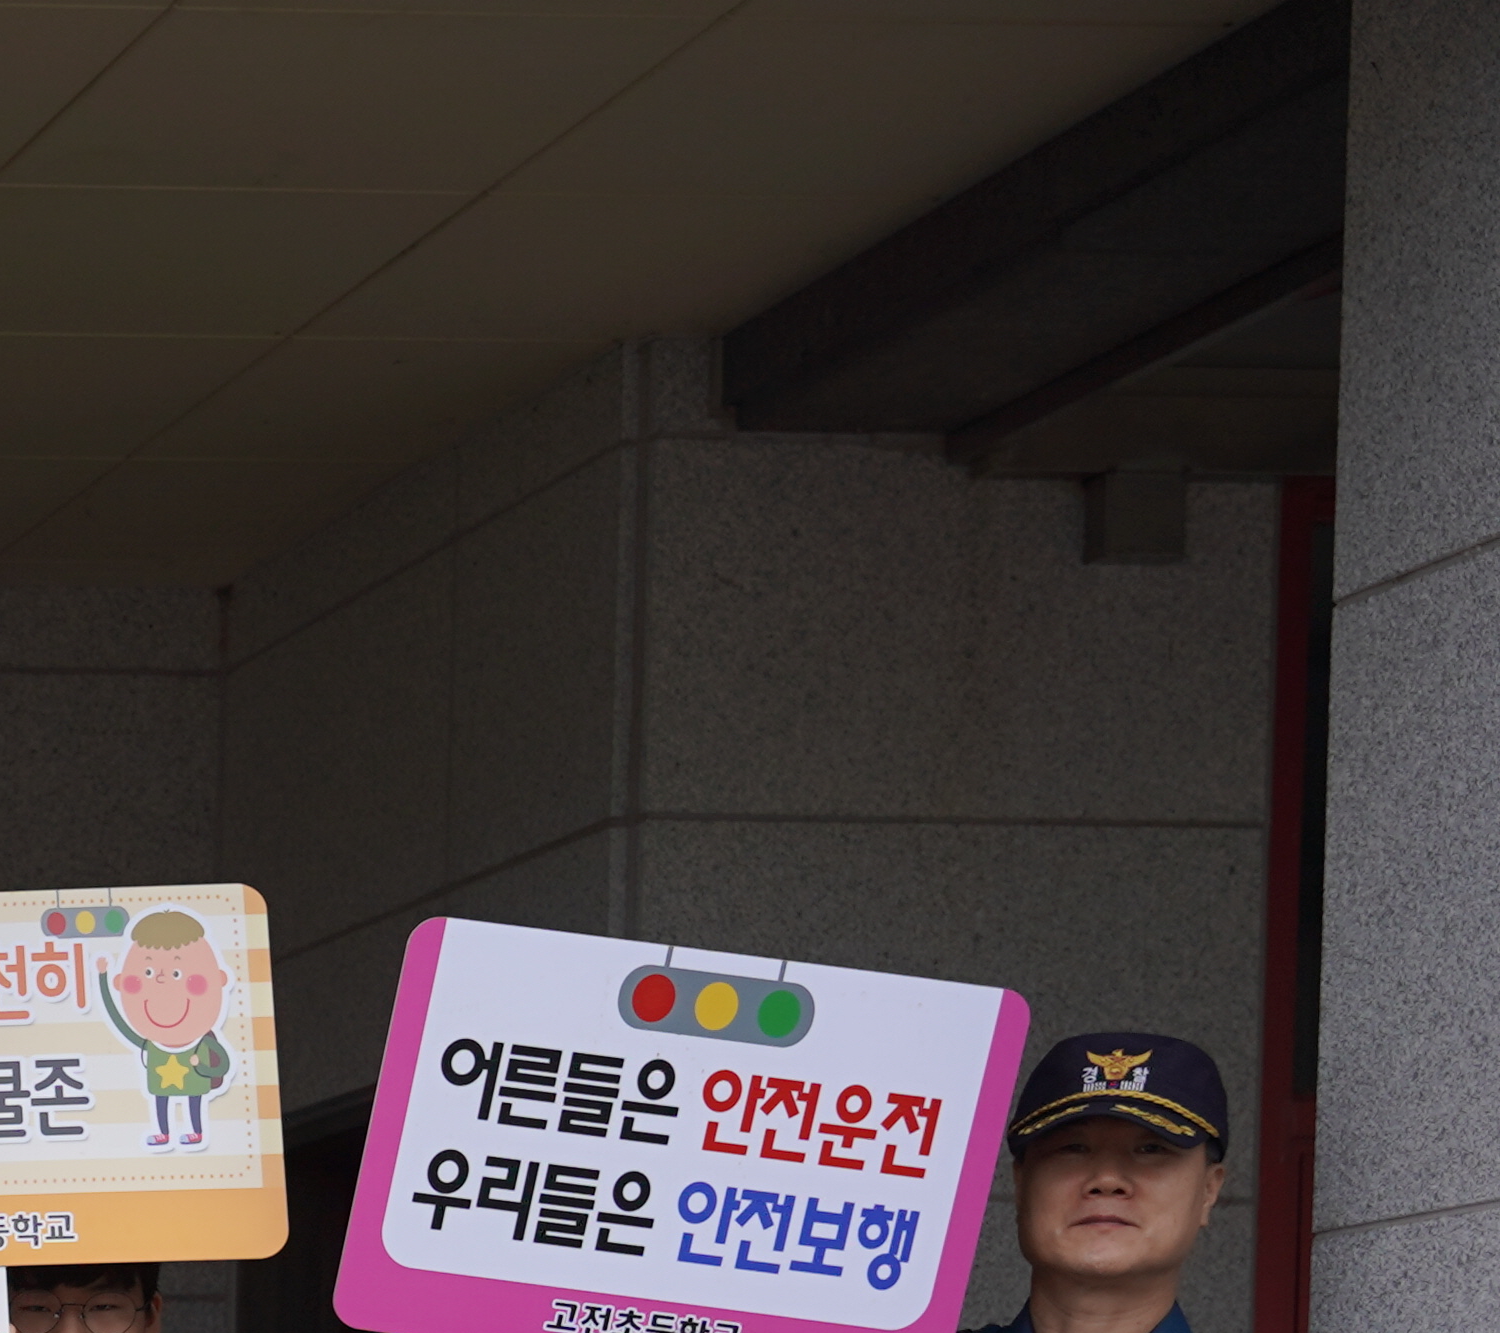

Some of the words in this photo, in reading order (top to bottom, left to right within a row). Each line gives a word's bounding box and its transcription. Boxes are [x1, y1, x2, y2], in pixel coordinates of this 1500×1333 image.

[439, 1037, 680, 1146] 어른들은
[701, 1068, 943, 1178] 안전운전
[411, 1148, 656, 1257] 우리들은
[676, 1179, 921, 1291] 안전보행
